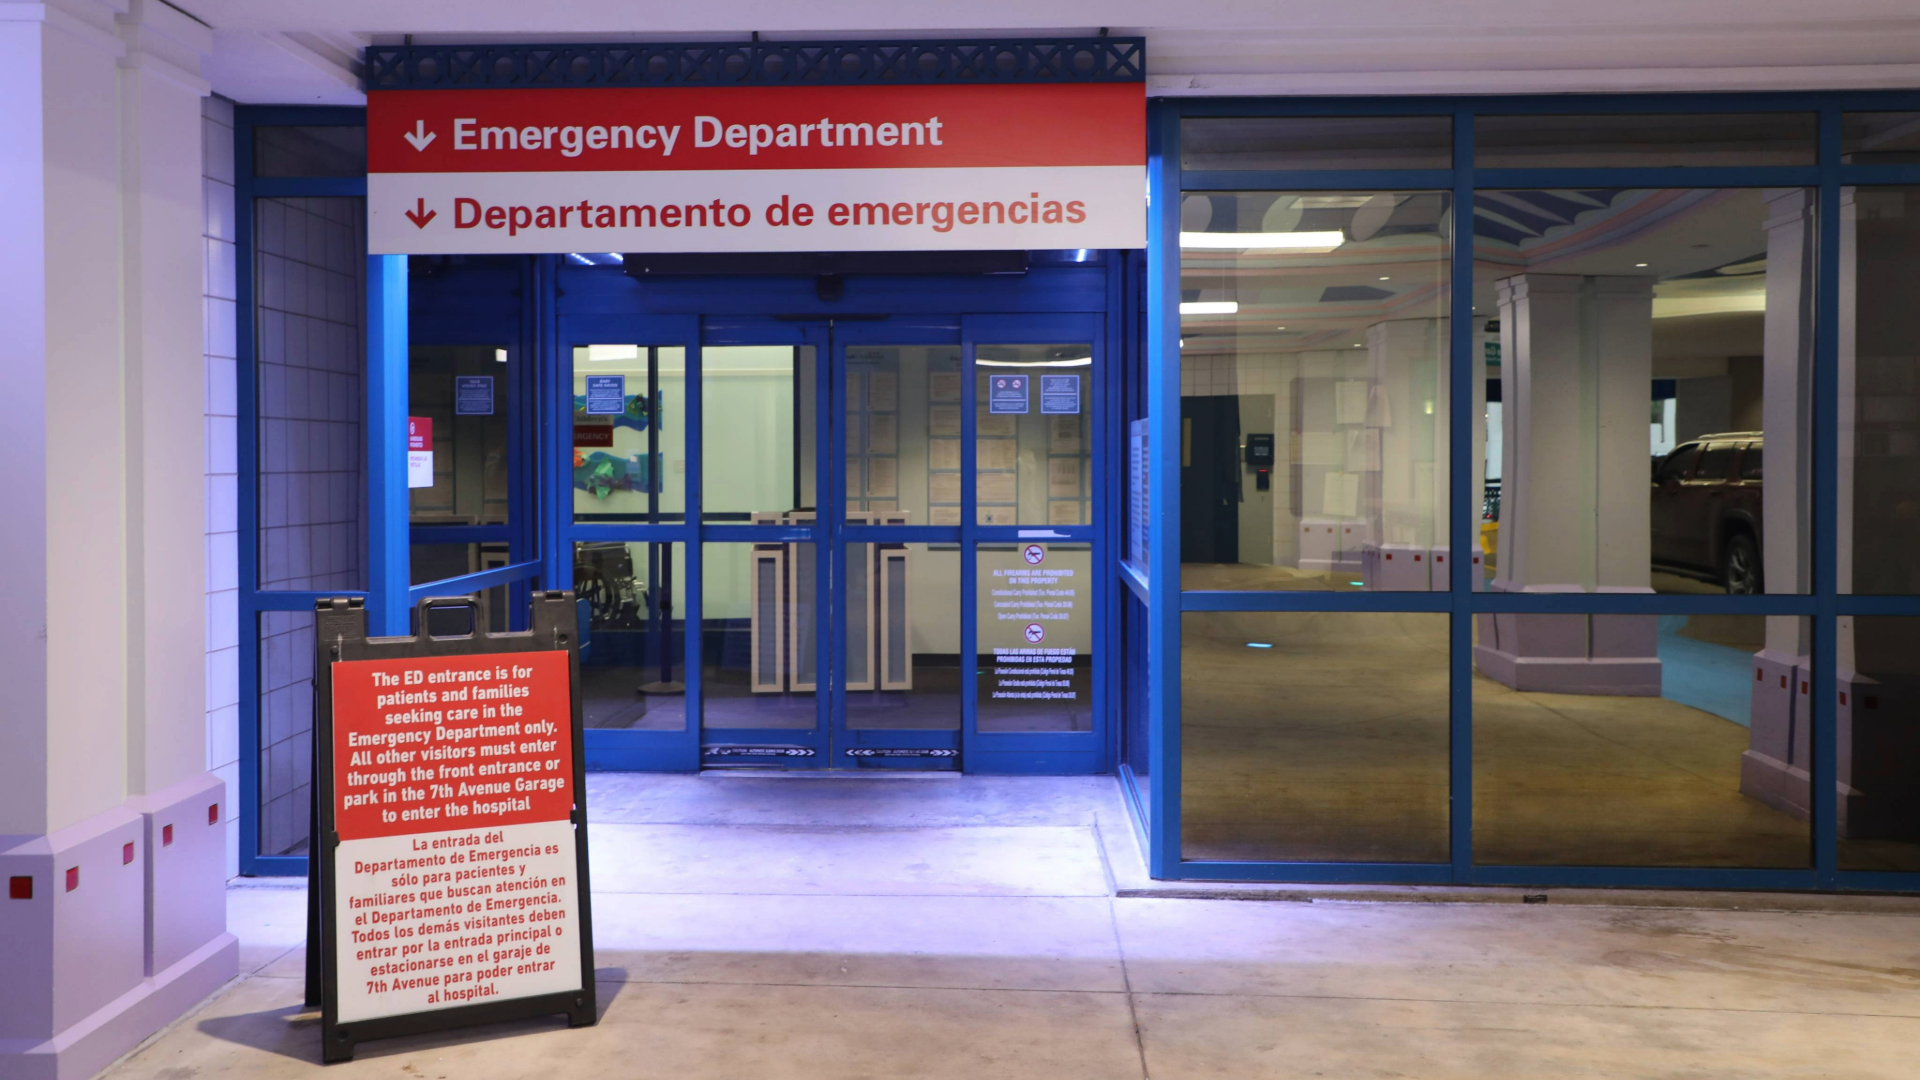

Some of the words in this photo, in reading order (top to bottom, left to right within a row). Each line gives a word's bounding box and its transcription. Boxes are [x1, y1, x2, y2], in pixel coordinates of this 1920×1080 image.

[454, 118, 680, 157] Emergency
[694, 115, 943, 155] Department
[453, 196, 752, 237] Departamento
[765, 194, 815, 227] de
[827, 192, 1086, 233] emergencias
[371, 671, 399, 686] The
[404, 669, 423, 685] ED
[427, 669, 491, 683] entrance
[495, 665, 508, 679] is
[512, 664, 532, 678] for
[377, 689, 437, 709] patients
[441, 686, 467, 701] and
[472, 683, 529, 699] families
[384, 708, 442, 725] seeking
[446, 708, 478, 720] care
[482, 704, 495, 718] in
[500, 702, 522, 717] the
[348, 730, 431, 747] Emergency
[435, 721, 520, 742] Department
[524, 719, 557, 736] only.
[350, 750, 372, 766] All
[376, 748, 416, 764] other
[420, 744, 475, 760] visitors
[480, 740, 515, 756] must
[519, 738, 556, 753] enter
[347, 767, 406, 786] through
[410, 766, 434, 780] the
[438, 763, 474, 778] front
[478, 760, 540, 775] entrance
[545, 759, 560, 770] or
[343, 789, 378, 809] park
[383, 788, 396, 802] in
[401, 786, 425, 801] the
[429, 783, 453, 798] 7th
[457, 781, 510, 796] Avenue
[514, 777, 564, 792] Garage
[382, 809, 396, 822] to
[401, 805, 440, 821] enter
[444, 802, 468, 816] the
[472, 795, 530, 815] hospital
[412, 838, 427, 850] La
[432, 833, 480, 849] entrada
[484, 830, 503, 843] del
[354, 854, 445, 874] Departamento
[450, 851, 464, 864] de
[469, 844, 540, 862] Emergencia
[544, 844, 558, 854] es
[391, 873, 418, 886] sólo
[422, 872, 450, 886] para
[455, 864, 514, 883] pacientes
[518, 864, 525, 876] y
[349, 892, 415, 908] familiares
[419, 889, 442, 903] que
[447, 884, 491, 897] buscan
[495, 876, 546, 892] atención
[551, 876, 565, 886] en
[355, 912, 367, 925] el
[371, 903, 462, 924] Departamento
[466, 900, 481, 912] de
[486, 891, 560, 910] Emergencia.
[351, 928, 389, 943] Todos
[394, 926, 413, 938] los
[417, 919, 459, 935] demás
[464, 913, 524, 929] visitantes
[528, 908, 565, 922] deben
[356, 946, 397, 960] entrar
[402, 943, 423, 957] por
[428, 939, 439, 951] la
[444, 932, 492, 949] entrada
[497, 924, 551, 946] principal
[555, 926, 562, 935] o
[370, 956, 453, 976] estacionarse
[458, 954, 472, 964] en
[477, 949, 488, 962] el
[492, 944, 531, 963] garaje
[535, 942, 550, 955] de
[366, 979, 387, 994] 7th
[391, 975, 439, 990] Avenue
[444, 971, 472, 986] para
[476, 964, 512, 982] poder
[517, 960, 554, 974] entrar
[427, 989, 439, 1003] al
[443, 982, 498, 1001] hospital.
